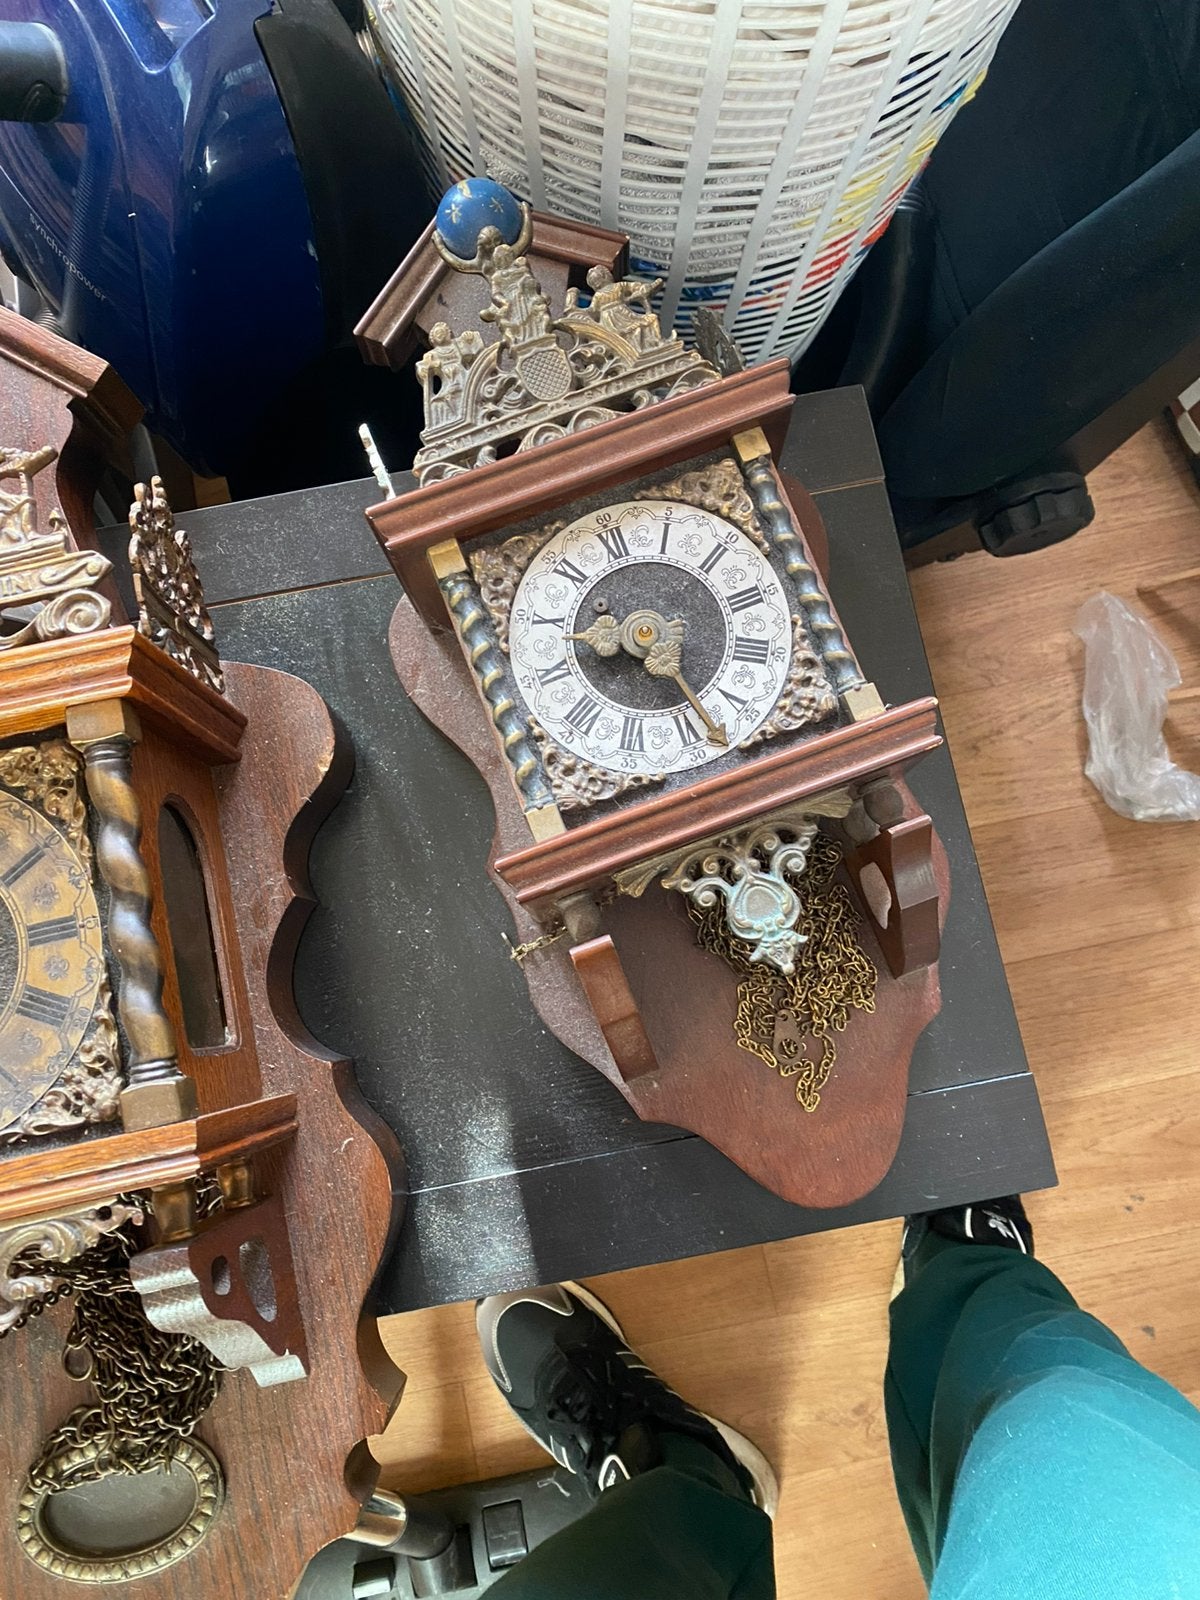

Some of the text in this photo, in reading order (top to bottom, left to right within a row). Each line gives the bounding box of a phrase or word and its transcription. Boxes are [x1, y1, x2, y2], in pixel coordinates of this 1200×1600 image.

[30, 213, 106, 300] synchropower
[595, 512, 612, 525] 60
[665, 506, 673, 516] 5
[596, 526, 632, 564] XII
[660, 523, 671, 554] I
[725, 531, 739, 545] 10
[541, 550, 557, 565] 55
[698, 542, 729, 576] II
[552, 558, 589, 590] XI
[726, 584, 764, 615] III
[766, 583, 779, 596] 15
[515, 608, 526, 625] 50
[531, 611, 565, 629] X
[733, 635, 770, 665] IIII
[775, 647, 786, 662] 20
[520, 676, 533, 689] 45
[535, 660, 574, 688] IX
[717, 687, 748, 714] V
[564, 693, 604, 738] VIII
[745, 709, 761, 723] 25
[558, 731, 575, 744] 40
[619, 716, 647, 752] VII
[672, 712, 704, 747] VI
[621, 758, 637, 769] 35
[689, 749, 706, 762] 30
[27, 914, 79, 947] III
